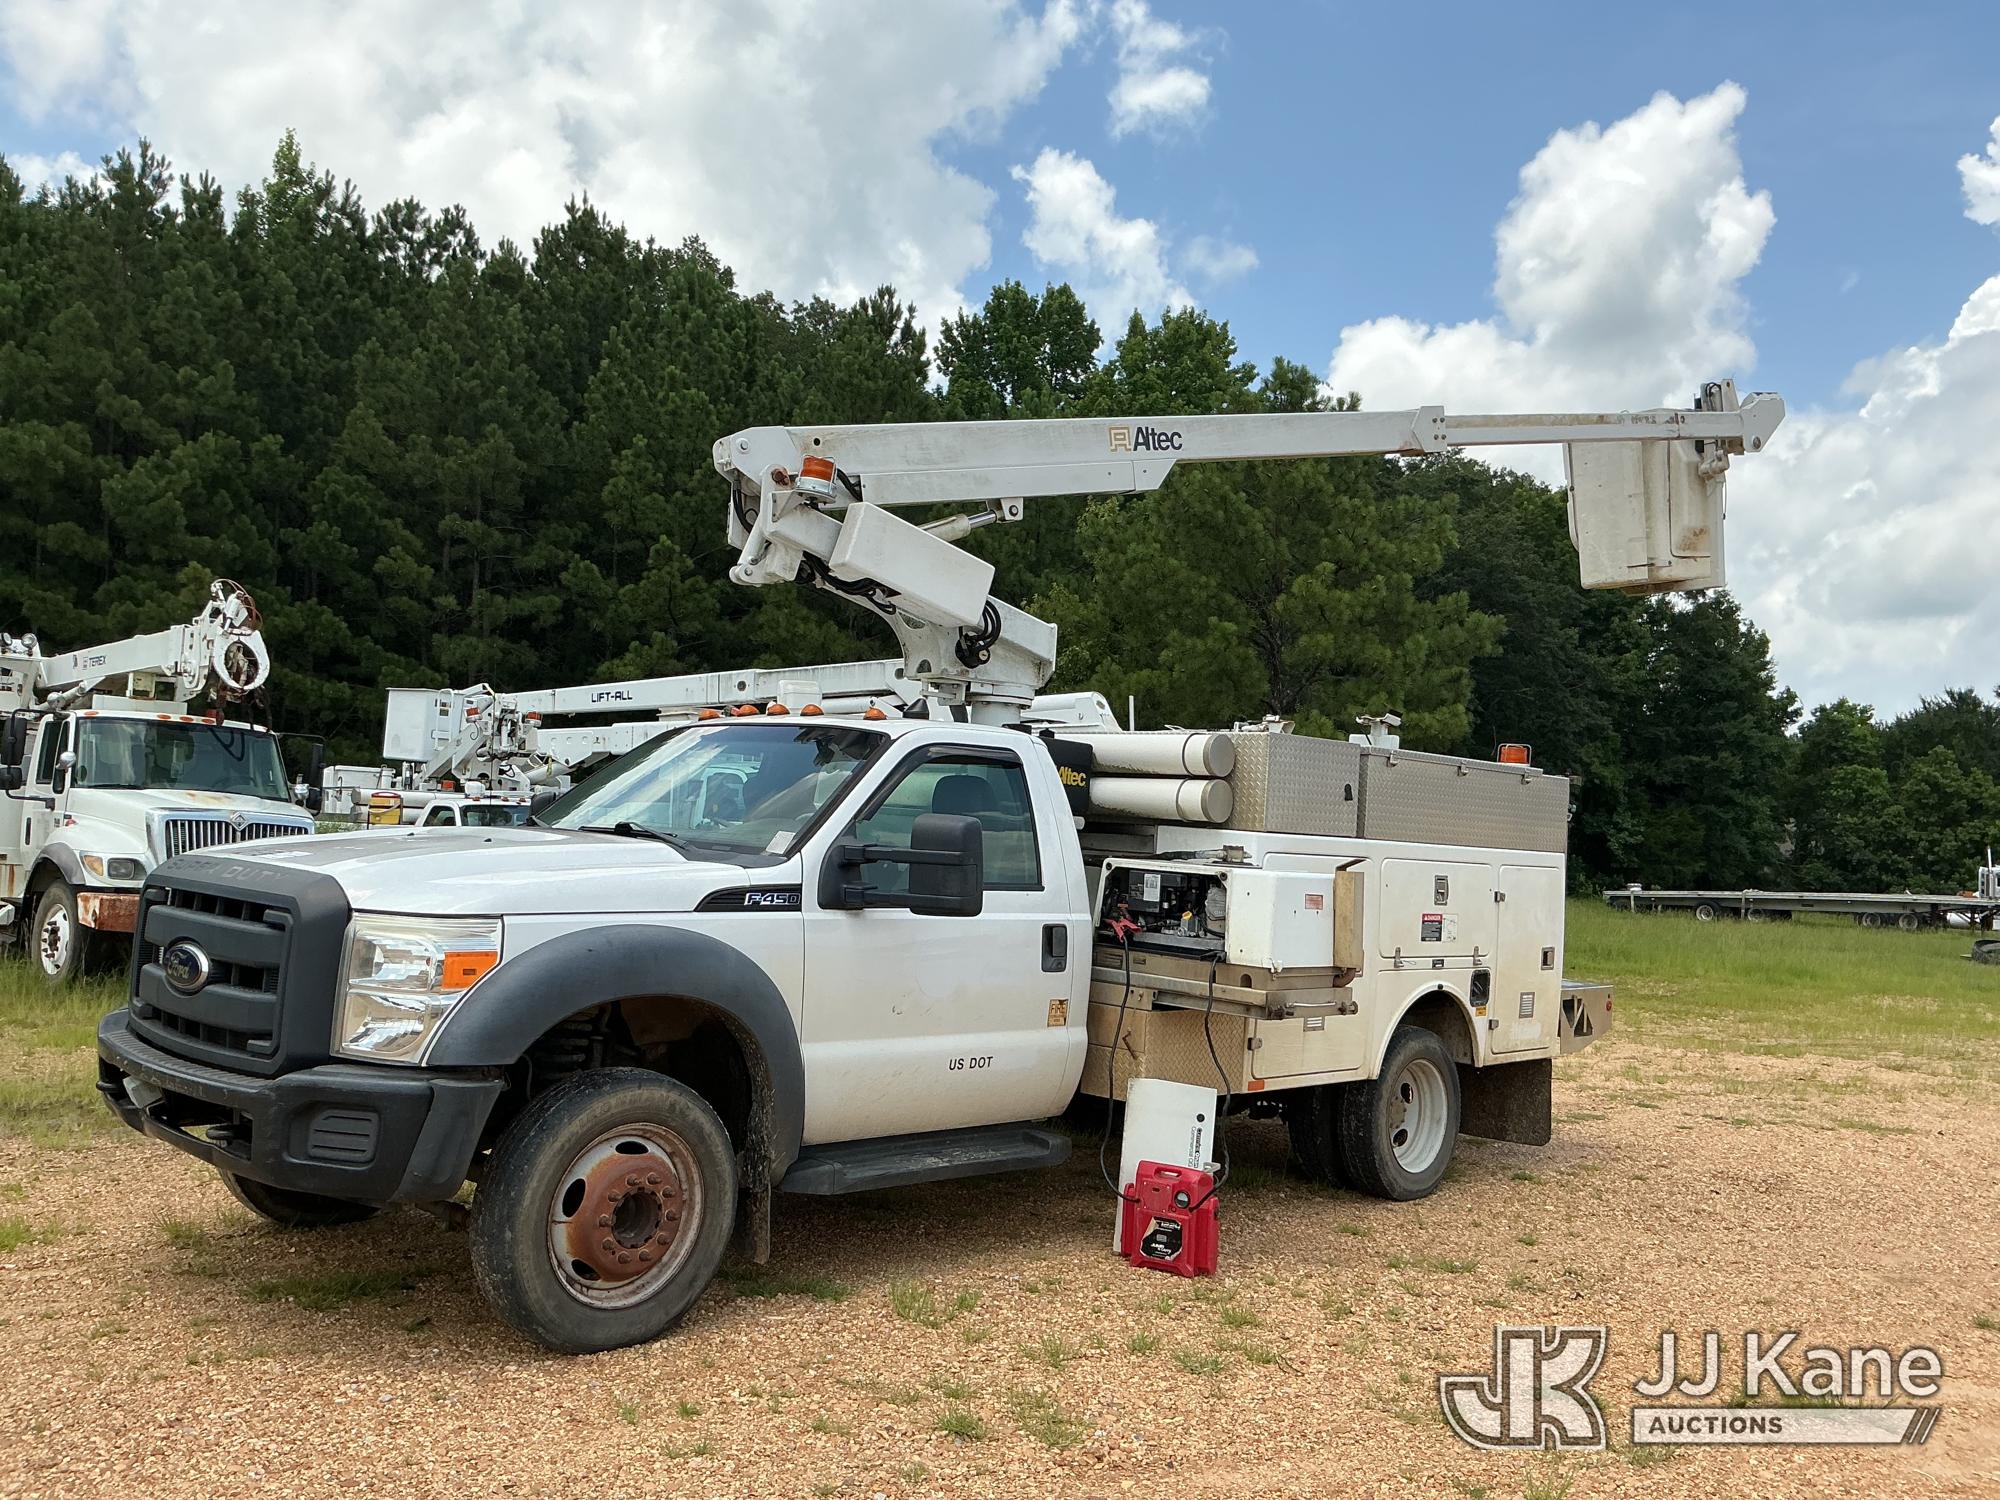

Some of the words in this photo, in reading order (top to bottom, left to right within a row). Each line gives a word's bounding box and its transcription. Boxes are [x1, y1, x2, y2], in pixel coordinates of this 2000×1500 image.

[1133, 426, 1183, 452] Altec
[591, 690, 633, 703] LIFT-ALL
[166, 951, 192, 979] Ford
[949, 1058, 965, 1071] US
[969, 1056, 994, 1069] DOT
